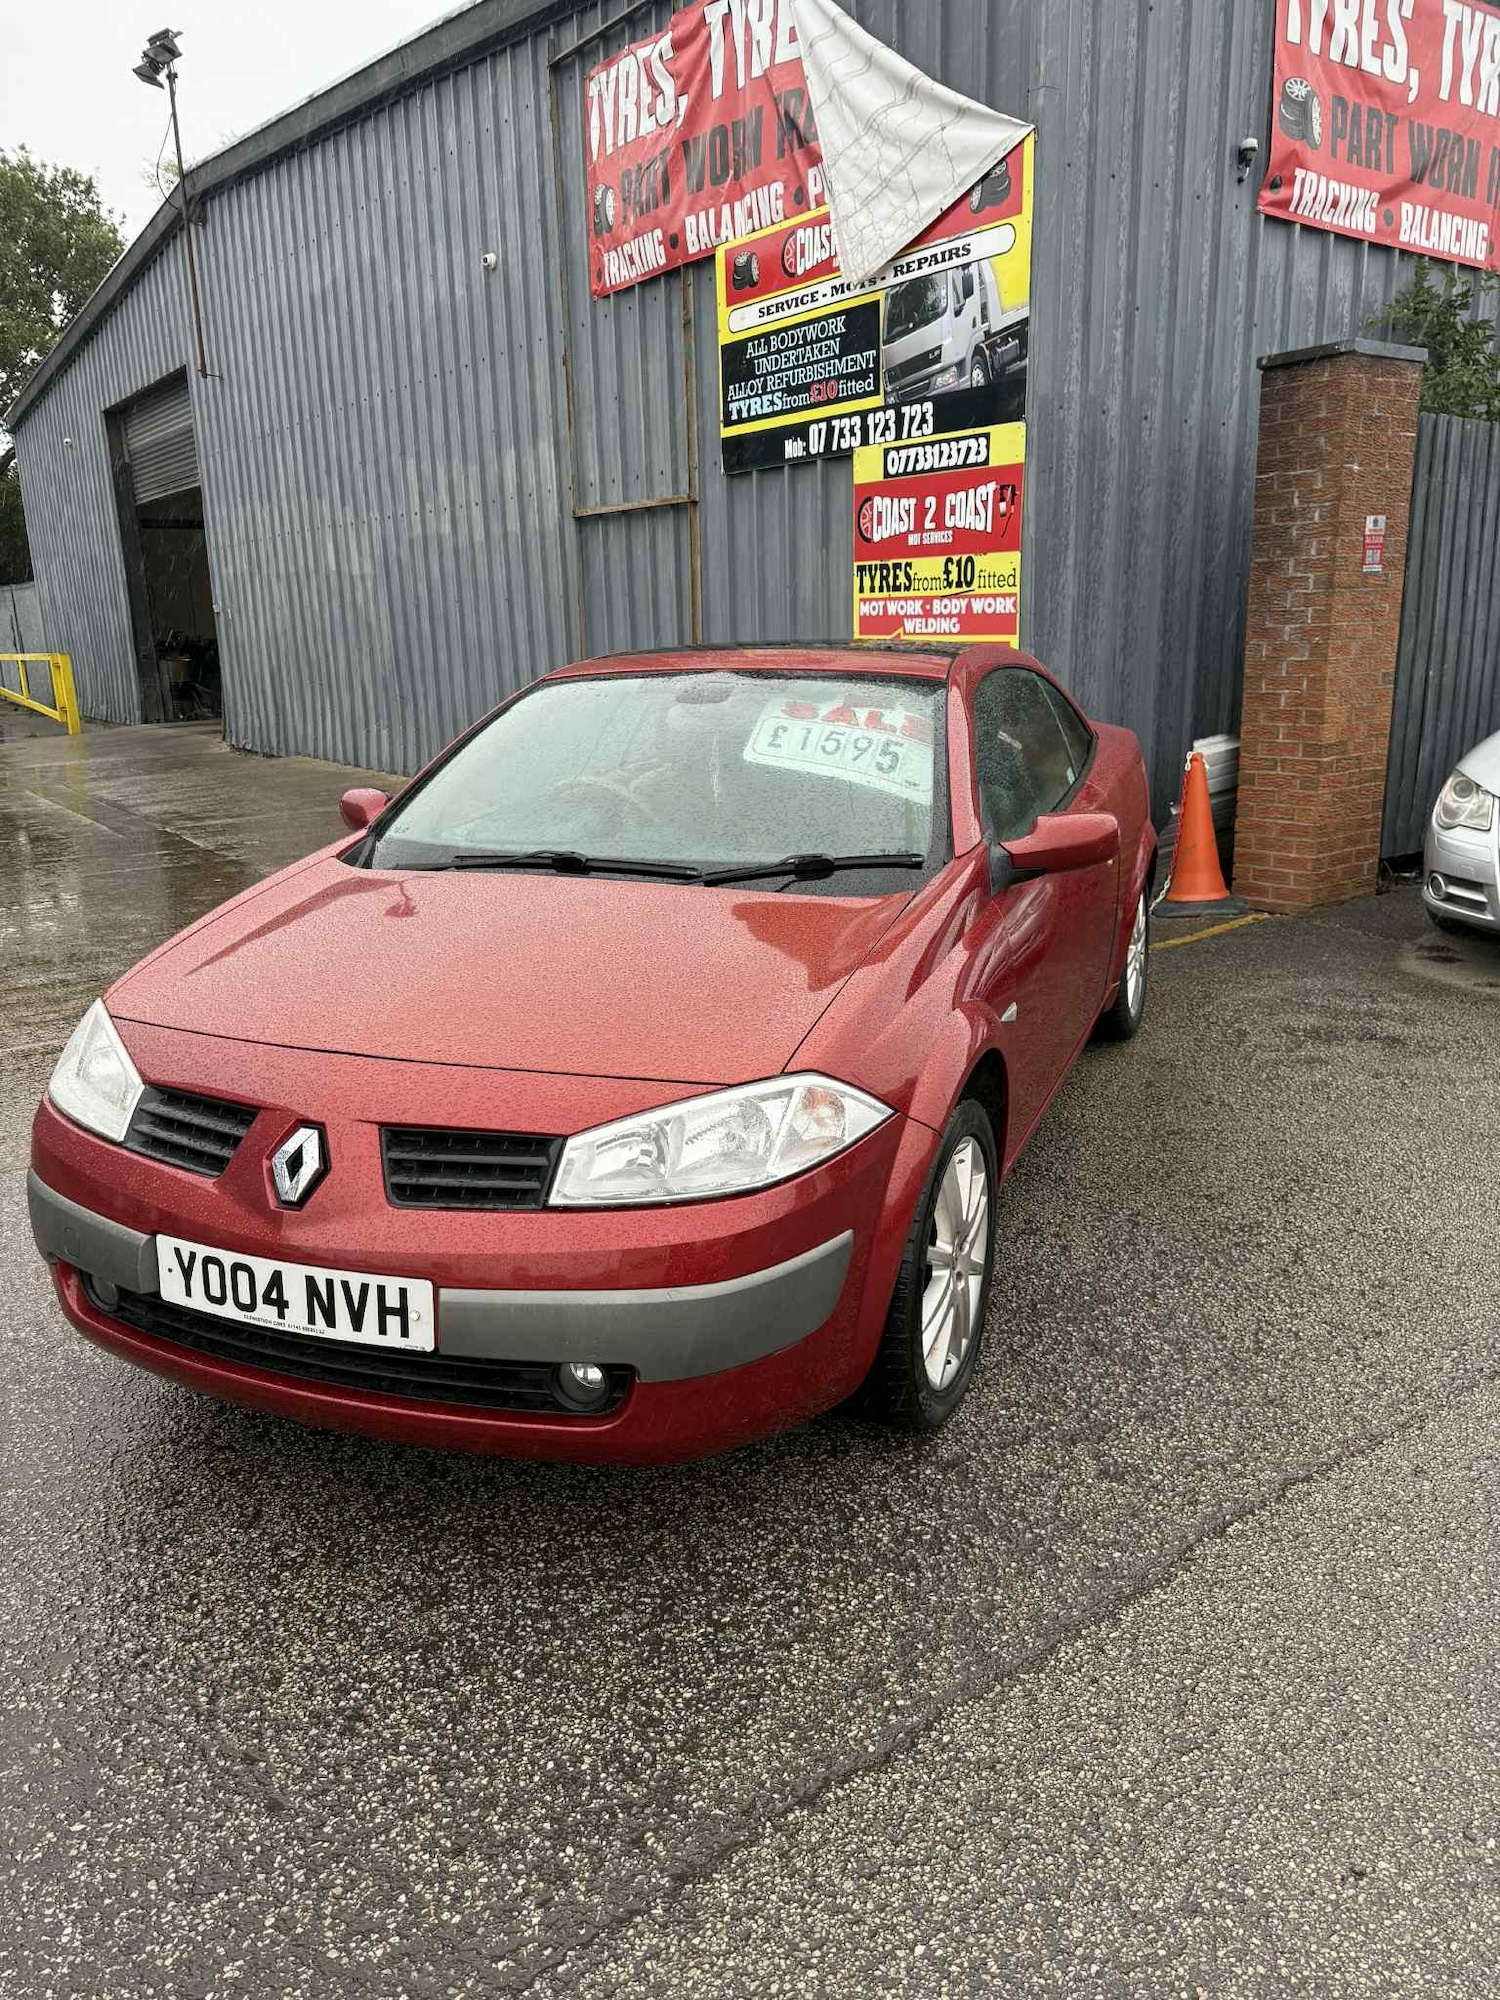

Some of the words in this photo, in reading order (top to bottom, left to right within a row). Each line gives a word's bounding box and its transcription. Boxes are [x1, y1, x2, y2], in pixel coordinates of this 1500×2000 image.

[620, 148, 672, 225] PART
[682, 105, 765, 197] WORN
[1330, 94, 1399, 175] PART
[1409, 120, 1482, 200] WORN
[604, 228, 667, 288] TRACKING
[685, 181, 785, 255] BALANCING
[1287, 168, 1381, 234] TRACKING
[1398, 203, 1490, 262] BALANCING
[758, 290, 819, 319] SERVICE
[892, 242, 973, 278] REPAIRS
[746, 337, 768, 358] ALL
[769, 316, 847, 352] BODYWORK
[754, 339, 840, 375] UNDERTAKEN
[727, 376, 764, 401] ALLOY
[766, 351, 877, 394] REFURBISHMENT
[728, 391, 783, 420] TYRES
[781, 389, 811, 411] from
[810, 380, 838, 404] £10
[838, 374, 875, 398] fitted
[784, 438, 807, 459] Mob:
[808, 422, 826, 451] 07
[831, 415, 862, 448] 733
[866, 409, 897, 442] 123
[901, 402, 934, 439] 723
[886, 437, 988, 475] 07733123723
[872, 495, 918, 542] COAST
[924, 496, 937, 530] 2
[944, 481, 997, 534] COAST
[907, 532, 921, 546] MOT
[922, 530, 953, 545] SERVICES
[856, 562, 913, 594] TYRES
[912, 571, 945, 592] from
[942, 555, 975, 589] £10
[977, 568, 1017, 589] fitted
[860, 601, 885, 616] MOT
[886, 599, 924, 615] WORK
[932, 599, 971, 615] BODY
[970, 597, 1017, 614] WORK
[903, 617, 961, 634] WELDING
[767, 724, 904, 775] £1595
[174, 1246, 290, 1320] YO04
[304, 1275, 410, 1339] NVH
